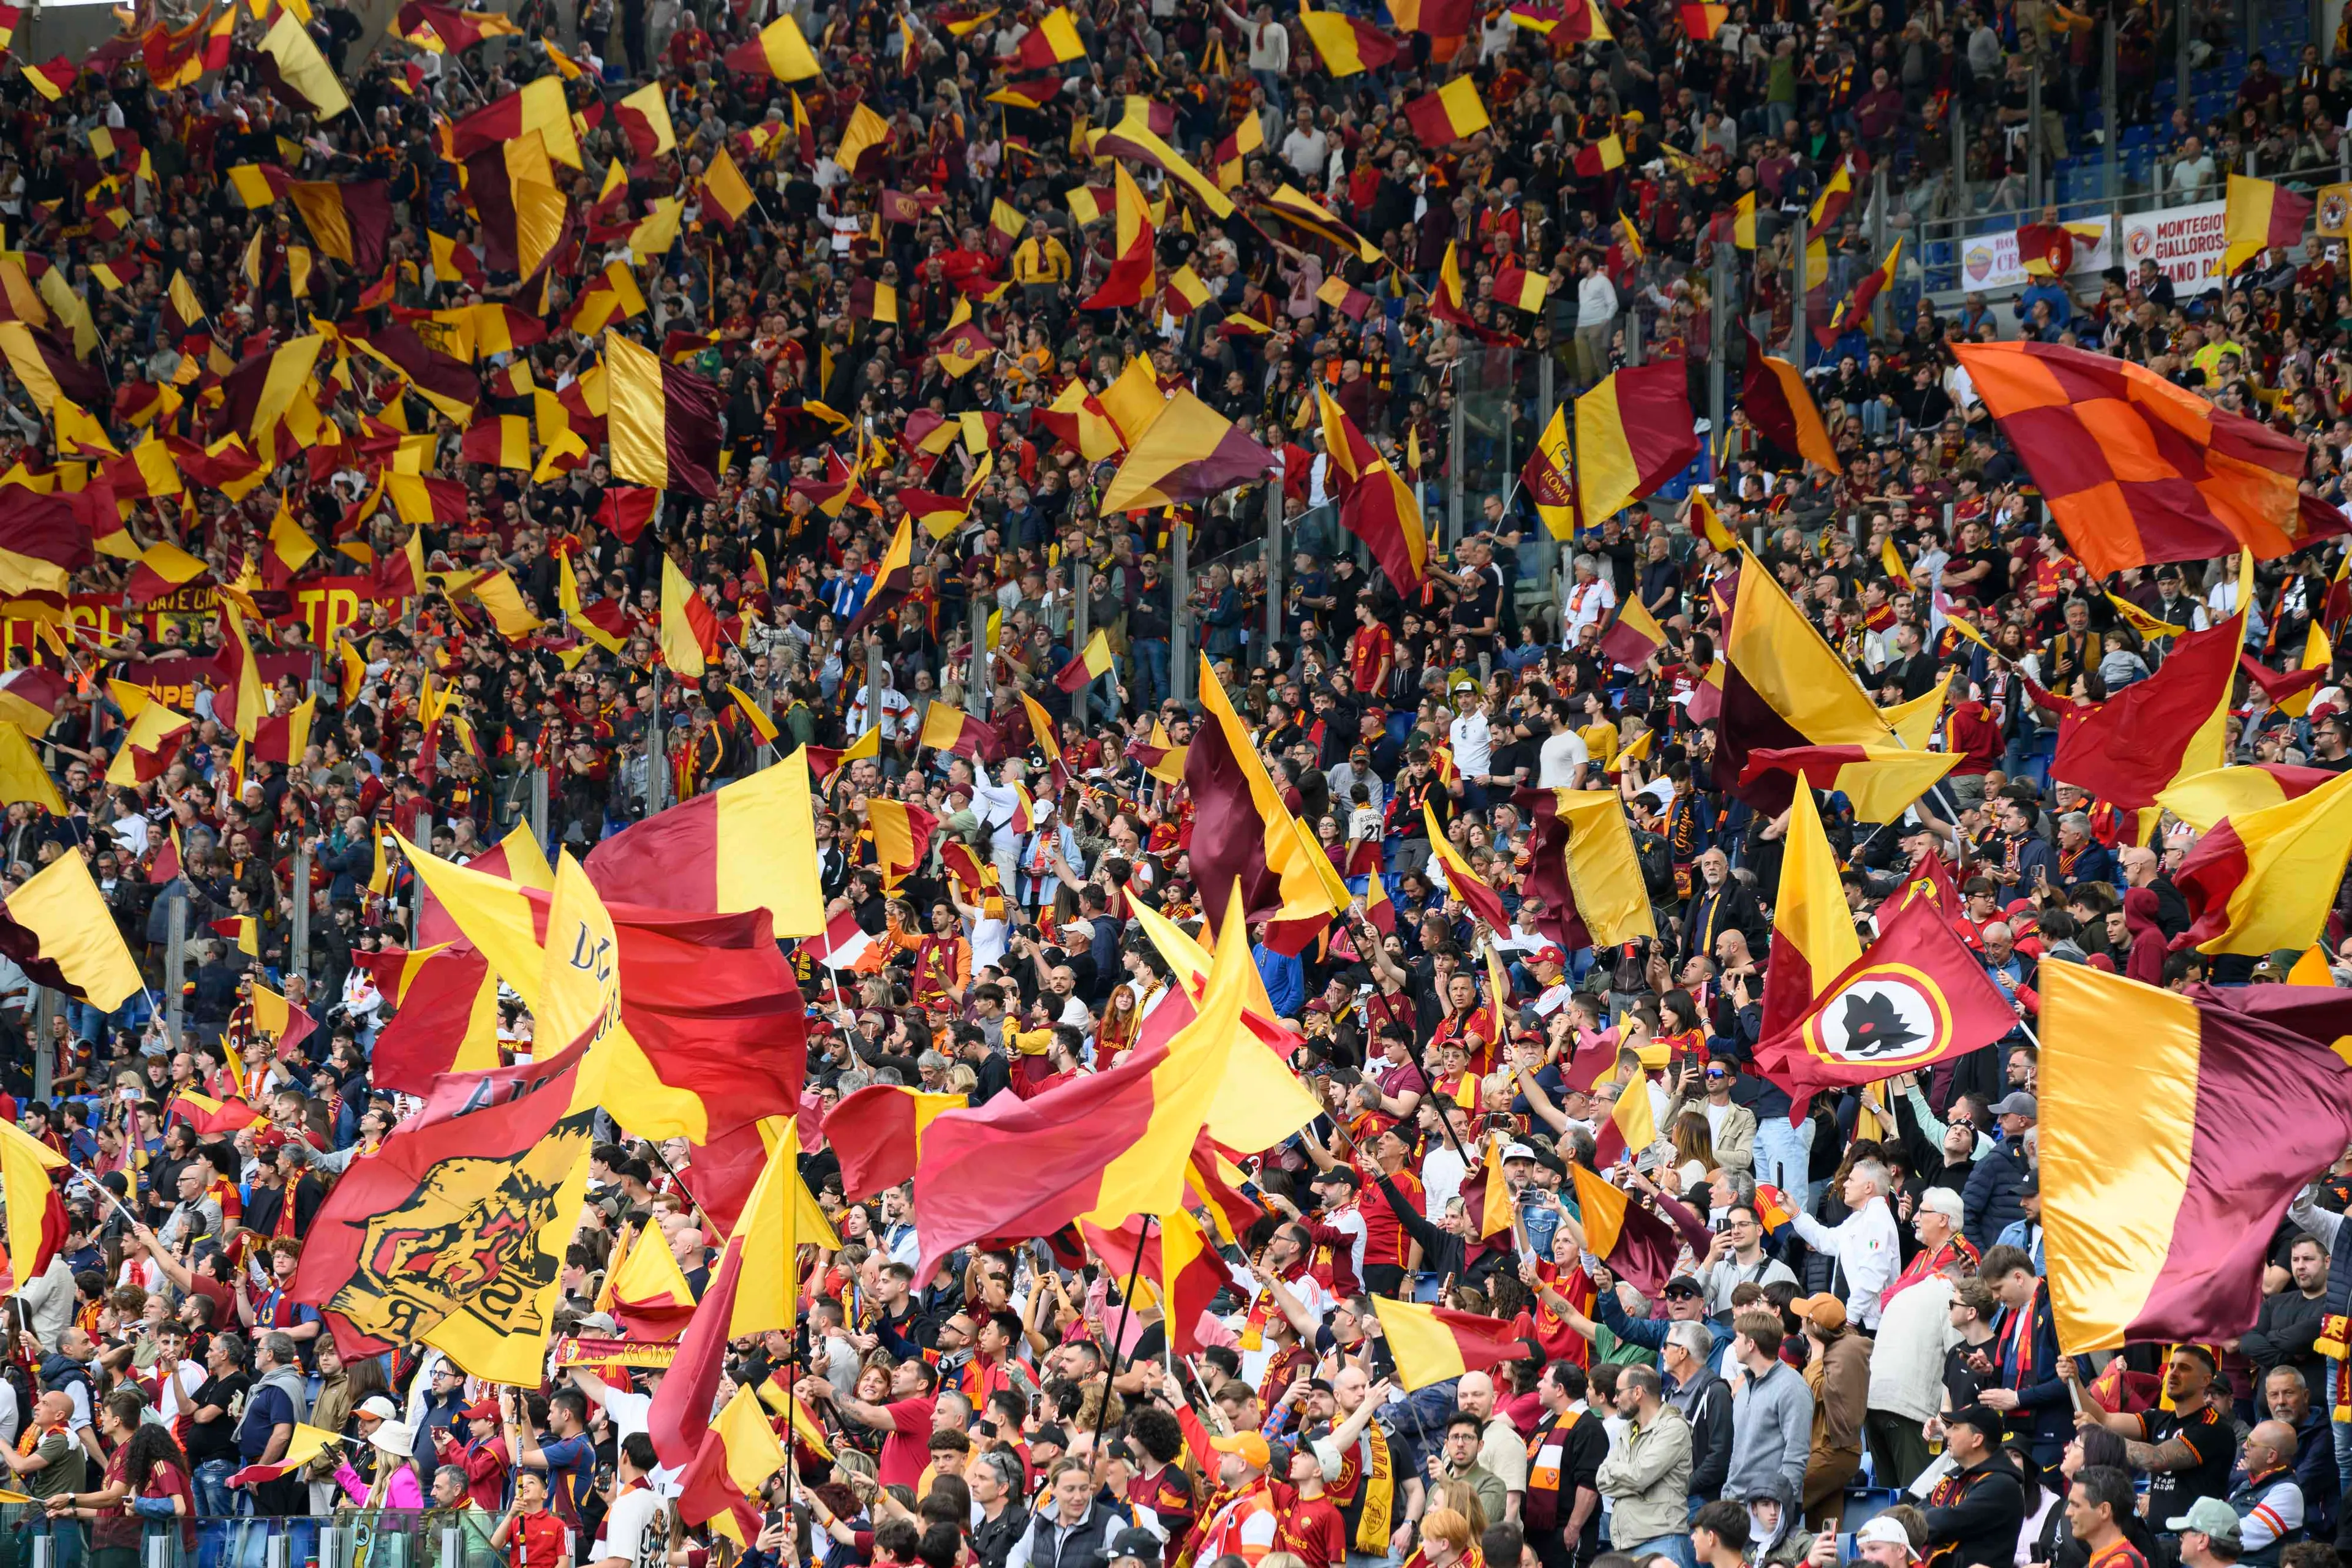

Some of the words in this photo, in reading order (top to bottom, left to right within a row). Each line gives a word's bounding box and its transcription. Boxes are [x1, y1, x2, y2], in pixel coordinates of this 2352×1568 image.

[1997, 254, 2019, 271] CE
[2129, 262, 2196, 288] GZANO
[1542, 469, 1570, 504] ROMA
[622, 1343, 676, 1364] ROM
[1370, 1423, 1388, 1480] OMA
